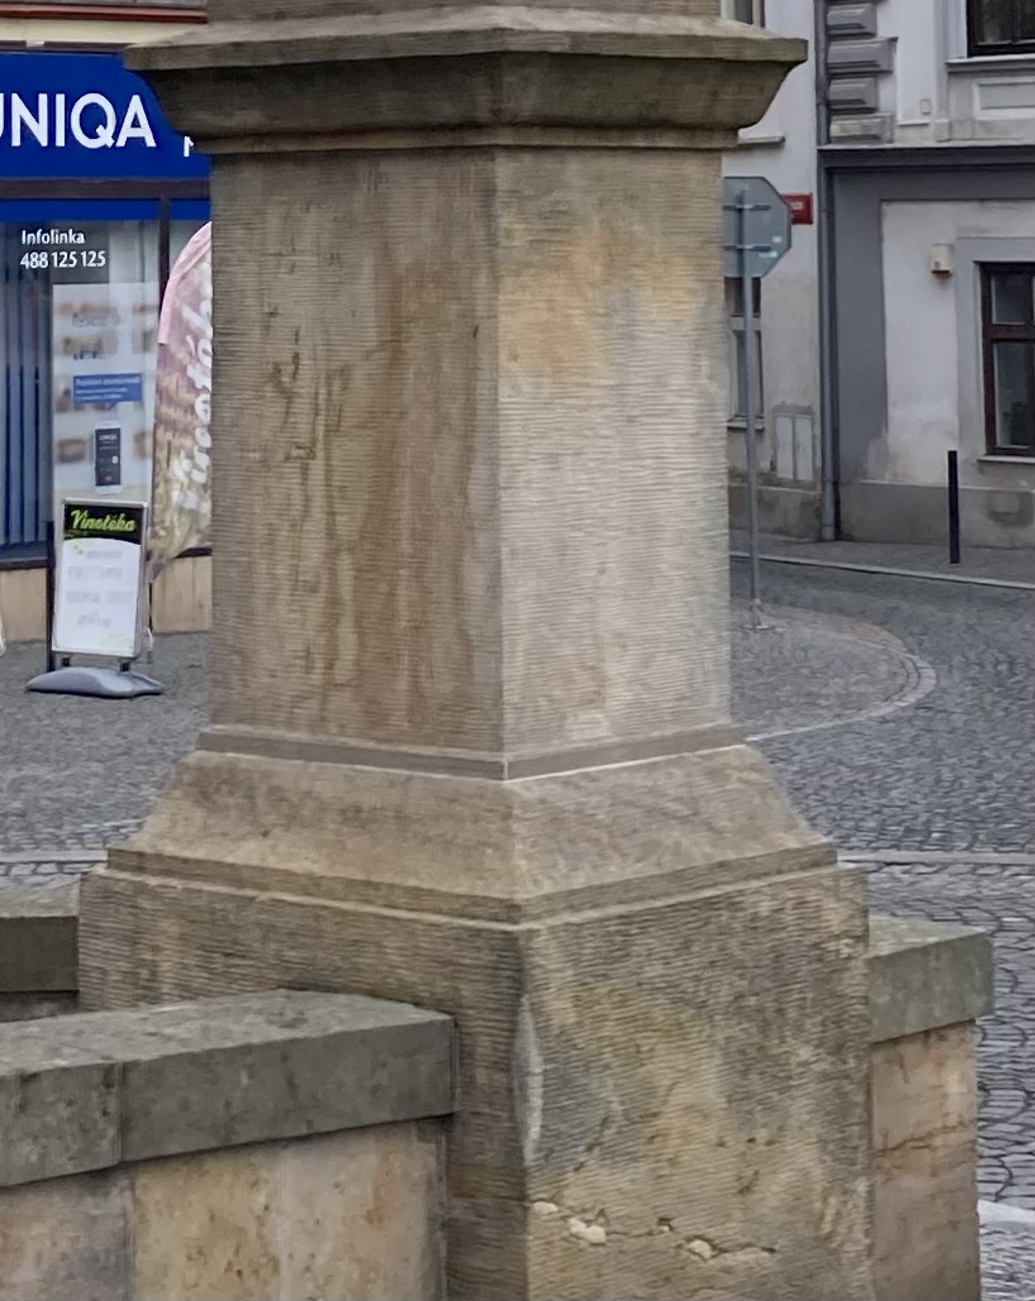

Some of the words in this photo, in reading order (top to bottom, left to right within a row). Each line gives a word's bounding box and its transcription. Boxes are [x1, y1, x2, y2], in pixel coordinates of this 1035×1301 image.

[21, 229, 86, 245] Infolinka
[20, 251, 49, 269] 488
[51, 250, 78, 268] 125
[80, 249, 106, 268] 125
